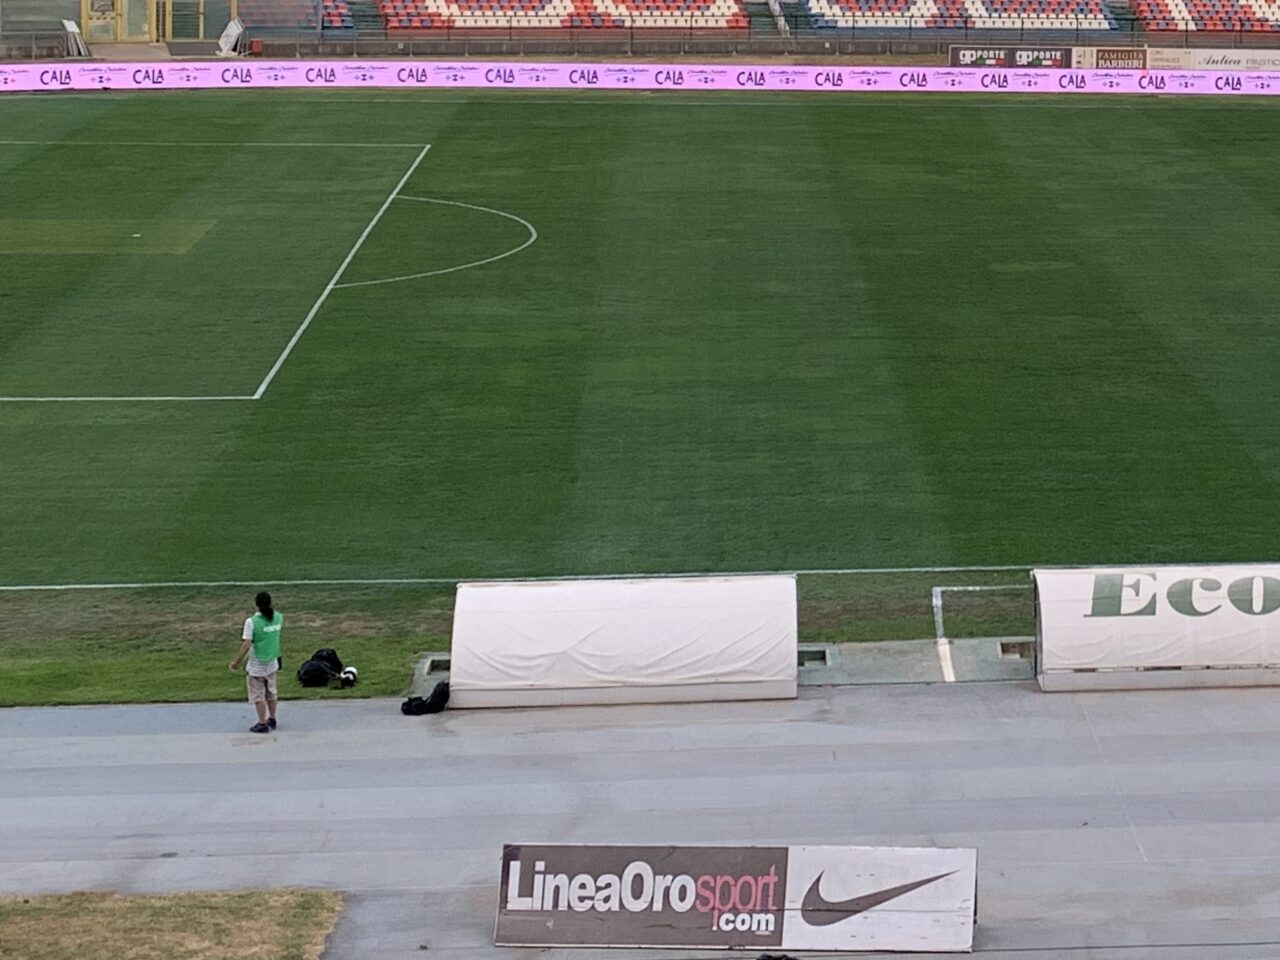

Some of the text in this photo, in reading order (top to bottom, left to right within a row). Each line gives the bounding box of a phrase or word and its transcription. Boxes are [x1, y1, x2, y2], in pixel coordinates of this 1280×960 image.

[977, 50, 1005, 60] PORTE
[1033, 50, 1062, 60] PORTE
[39, 69, 72, 85] CALA
[132, 69, 165, 85] CALA
[221, 68, 253, 84] CALA
[305, 67, 336, 83] CALA
[397, 67, 428, 83] CALA
[485, 68, 515, 84] CALA
[568, 69, 599, 85] CALA
[654, 70, 685, 86] CALA
[736, 71, 766, 86] CALA
[814, 72, 844, 87] CALA
[899, 72, 928, 87] CALA
[980, 73, 1009, 88] CALA
[1058, 74, 1087, 89] CALA
[1138, 75, 1166, 89] CALA
[1214, 76, 1242, 90] CALA
[712, 911, 775, 932] .com
